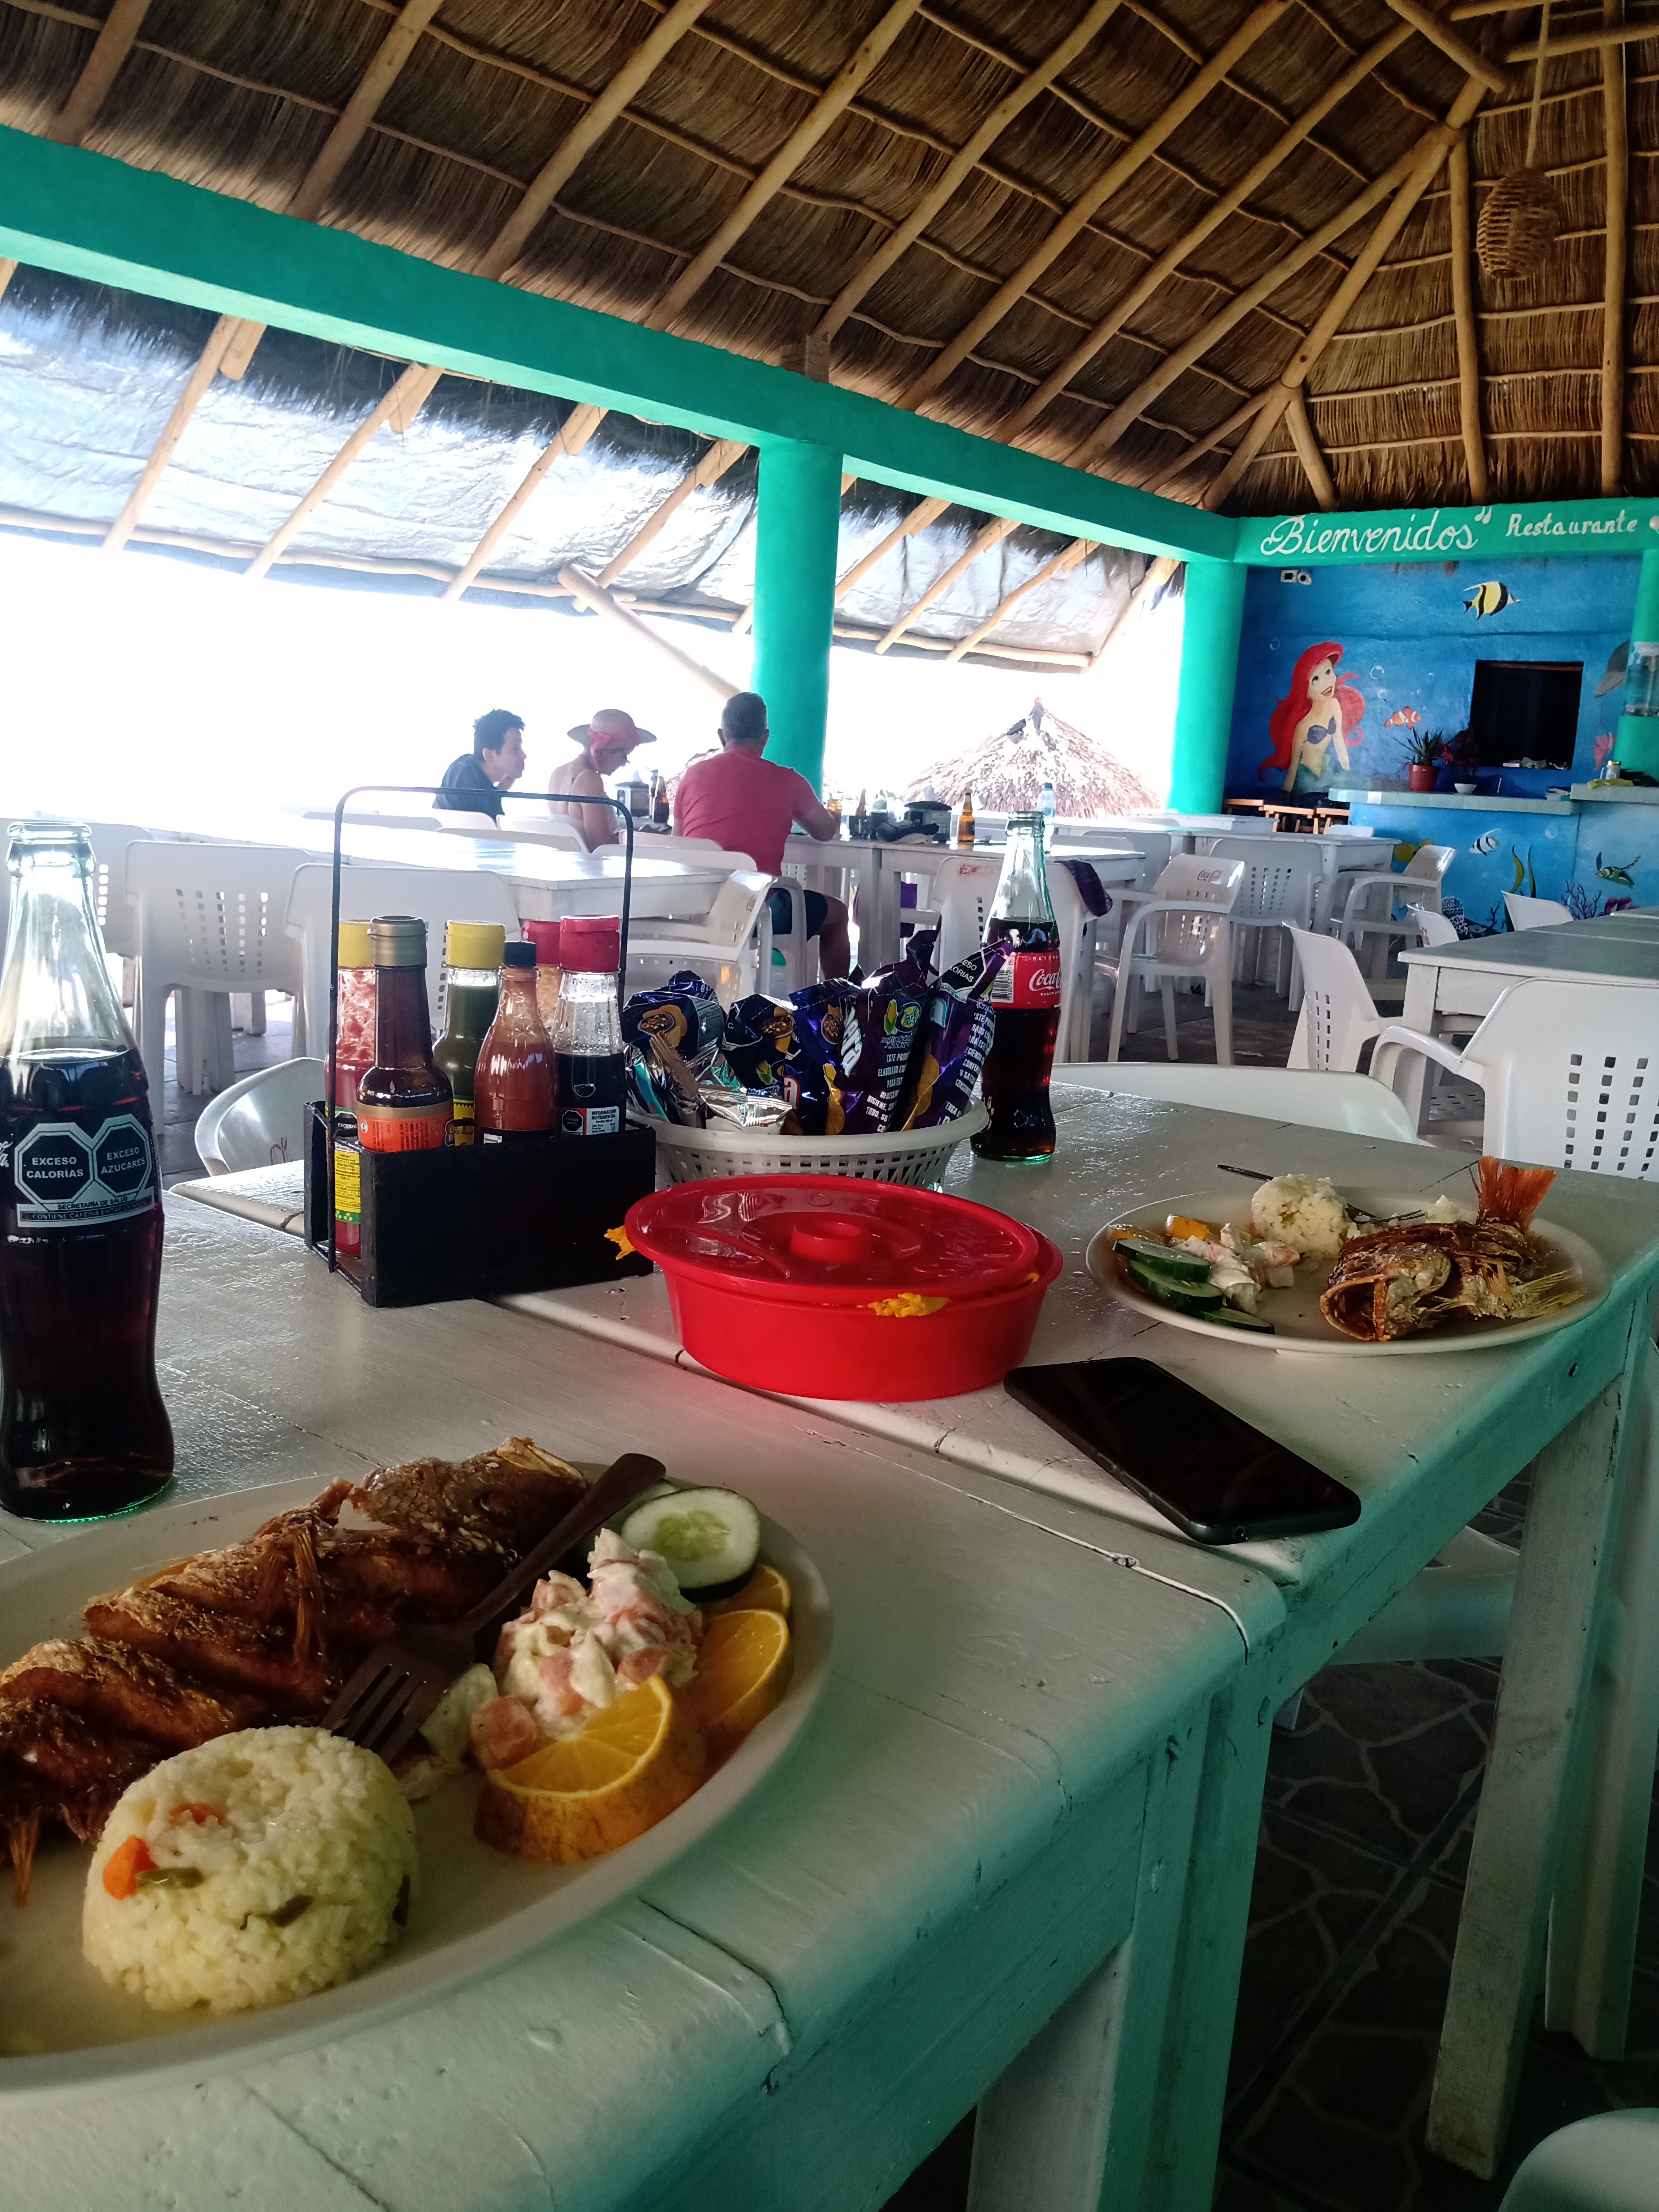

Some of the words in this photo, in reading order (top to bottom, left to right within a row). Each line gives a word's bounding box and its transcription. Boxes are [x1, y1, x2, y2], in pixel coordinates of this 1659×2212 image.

[1506, 509, 1638, 537] Restaurante
[960, 959, 977, 971] ESO
[106, 1146, 140, 1160] EXCESO
[31, 1157, 77, 1166] EXCESO
[27, 1168, 83, 1178] CALORÍAS
[57, 1200, 99, 1210] SECRETARÍA
[108, 1196, 129, 1205] SALUD
